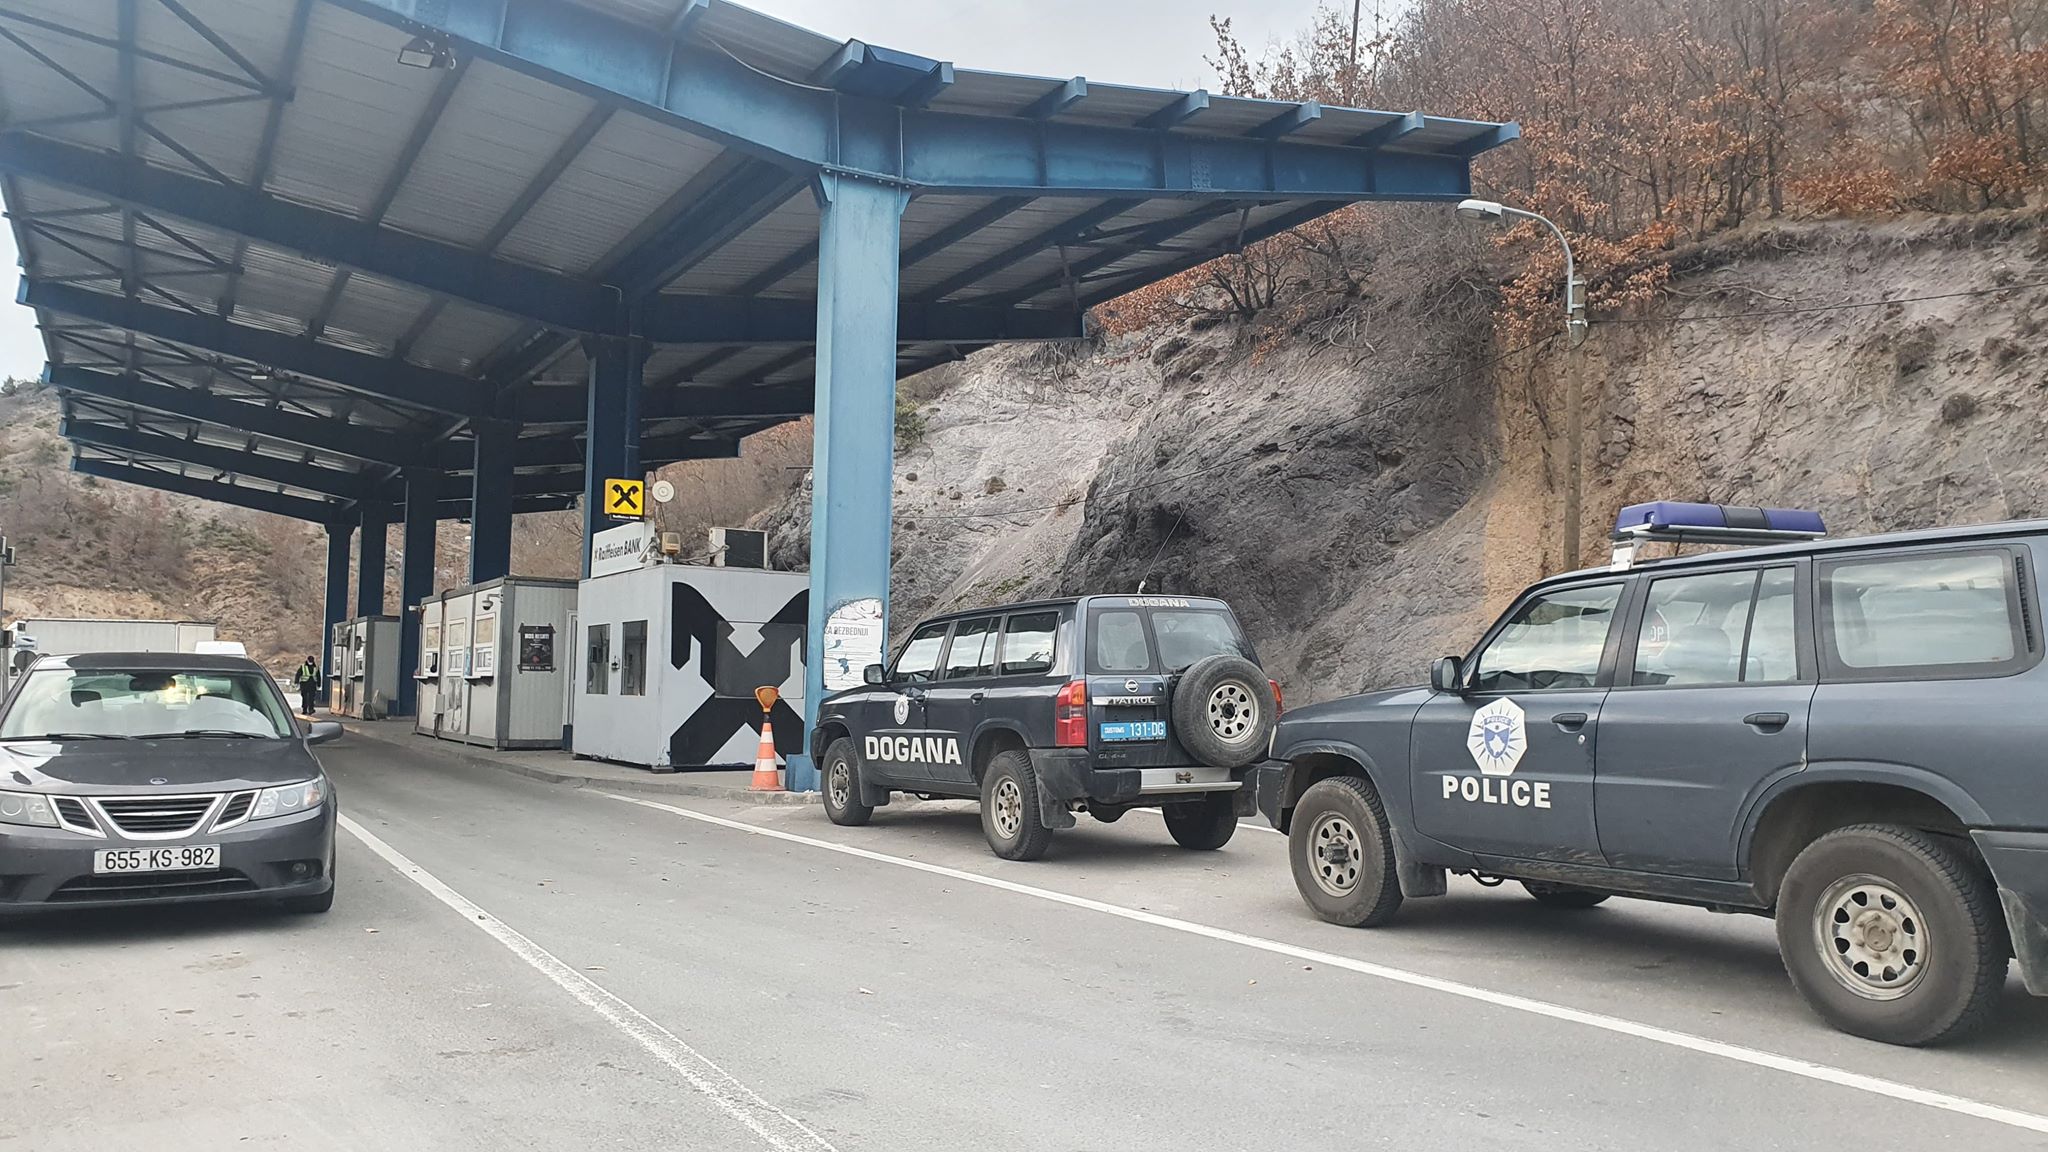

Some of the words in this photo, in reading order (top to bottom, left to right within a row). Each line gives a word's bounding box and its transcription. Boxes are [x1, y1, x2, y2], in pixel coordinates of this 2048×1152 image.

[624, 537, 641, 555] BANK
[1128, 598, 1190, 607] DOGANA
[1112, 696, 1155, 705] PATROL
[1486, 716, 1510, 724] POLICE
[865, 736, 962, 765] DOGANA
[1442, 775, 1551, 809] POLICE
[105, 847, 215, 870] 655-KS-982
